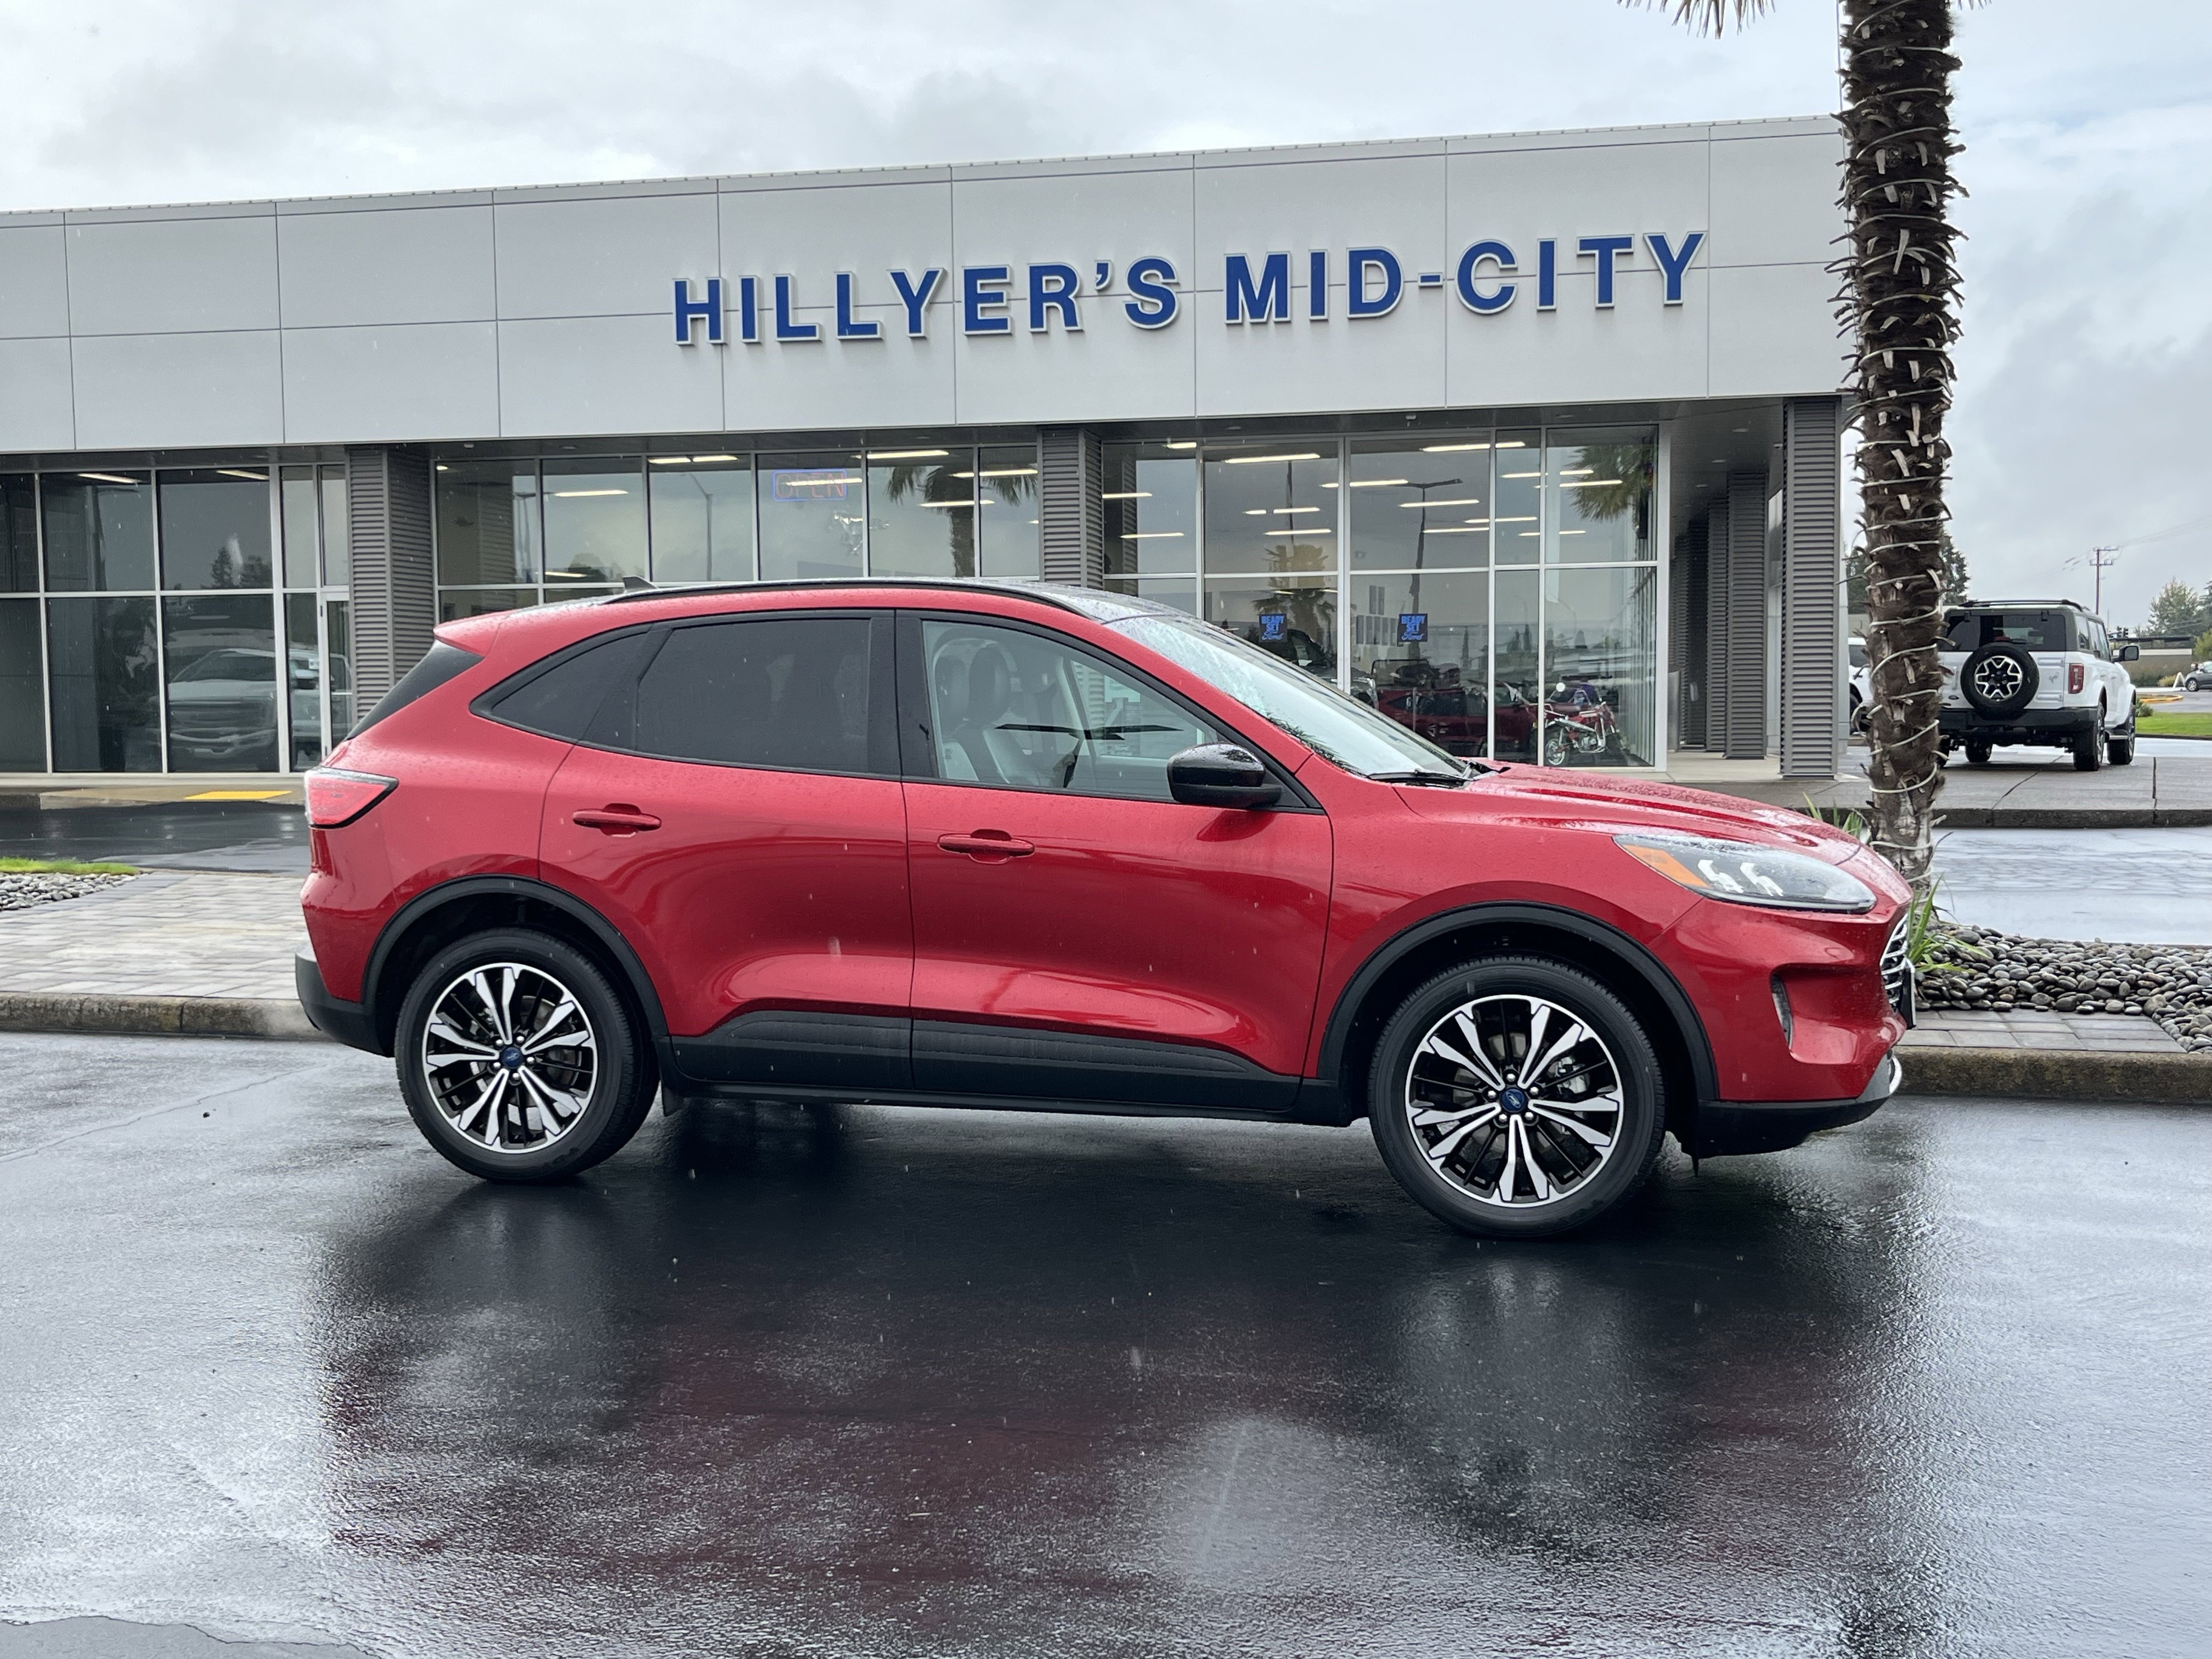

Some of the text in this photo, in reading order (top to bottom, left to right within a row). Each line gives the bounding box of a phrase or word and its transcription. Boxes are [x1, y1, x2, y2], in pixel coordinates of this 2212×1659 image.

[673, 230, 1707, 345] HILLYER'S MID-CITY
[776, 472, 844, 498] OPEN
